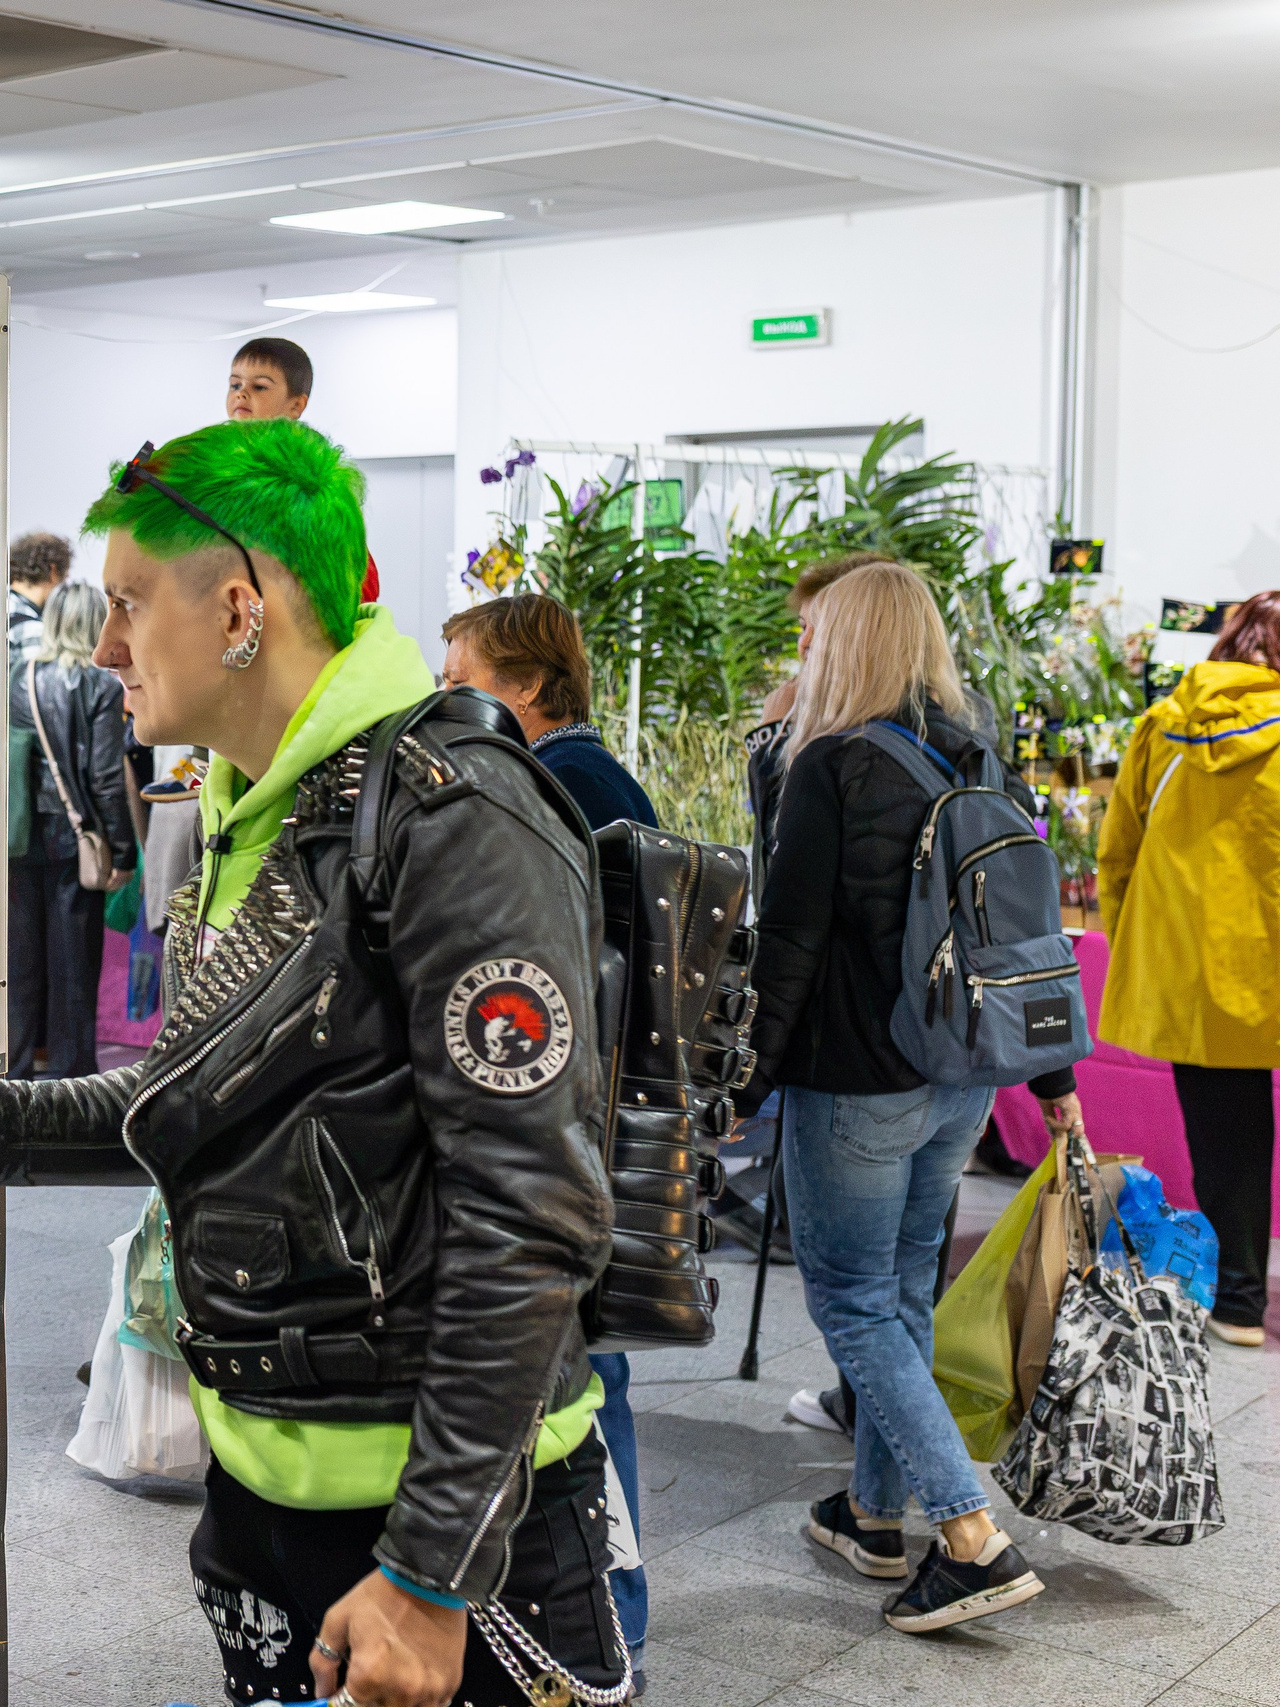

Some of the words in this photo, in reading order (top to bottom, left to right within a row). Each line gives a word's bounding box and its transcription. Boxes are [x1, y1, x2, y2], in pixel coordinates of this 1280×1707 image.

[762, 320, 808, 335] ВЫХОД
[470, 961, 514, 987] NOT
[471, 1060, 534, 1089] PUNK
